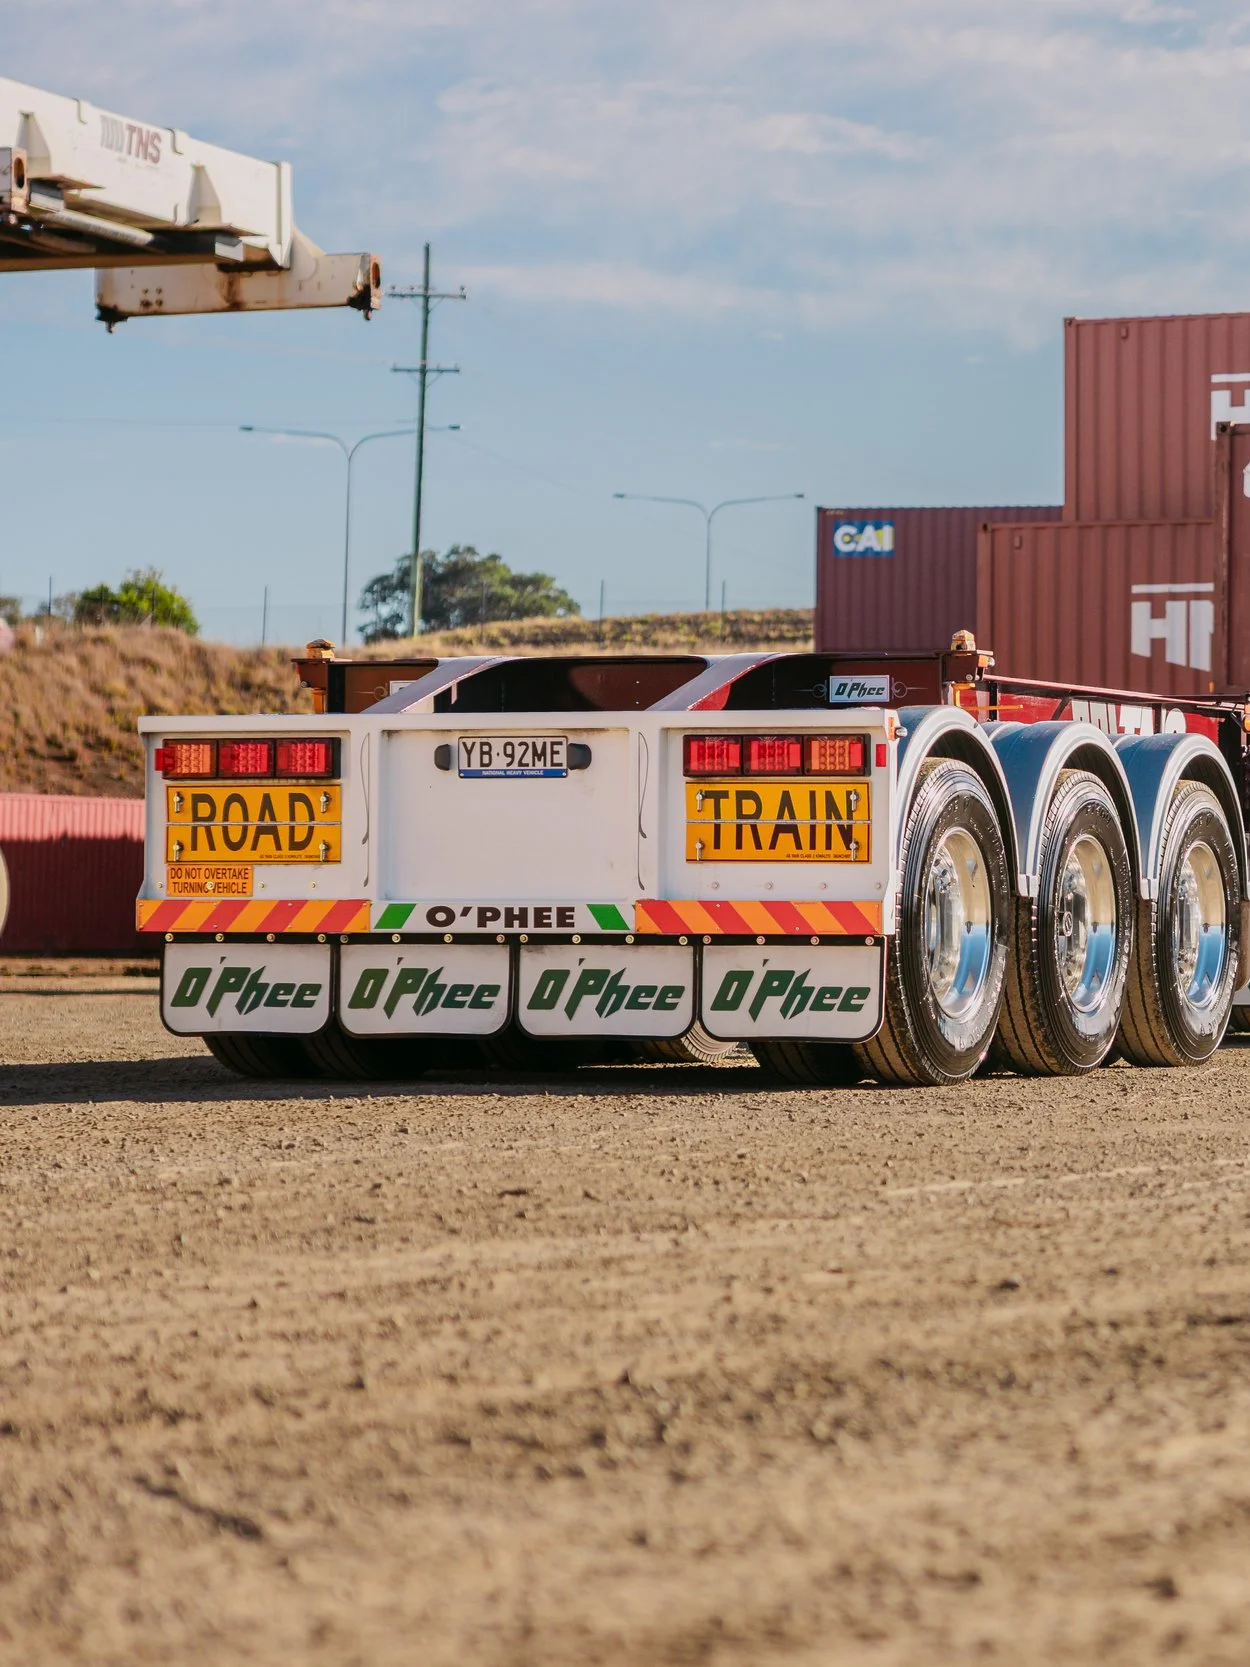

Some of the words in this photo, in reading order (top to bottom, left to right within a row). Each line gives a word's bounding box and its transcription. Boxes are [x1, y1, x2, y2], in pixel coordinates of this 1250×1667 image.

[834, 524, 895, 552] CAI
[191, 793, 315, 851] ROAD
[703, 790, 854, 851] TRAIN
[170, 868, 182, 880] DO
[185, 868, 202, 880] NOT
[204, 868, 249, 880] OVERTAKE
[172, 882, 209, 894] TURNING
[212, 881, 247, 894] VEHICLE
[426, 906, 575, 929] O'PHEE
[170, 956, 322, 1018] O'Phee
[348, 957, 501, 1019] O'Phee
[527, 958, 685, 1021] O'Phee
[710, 958, 871, 1022] O'Phee
